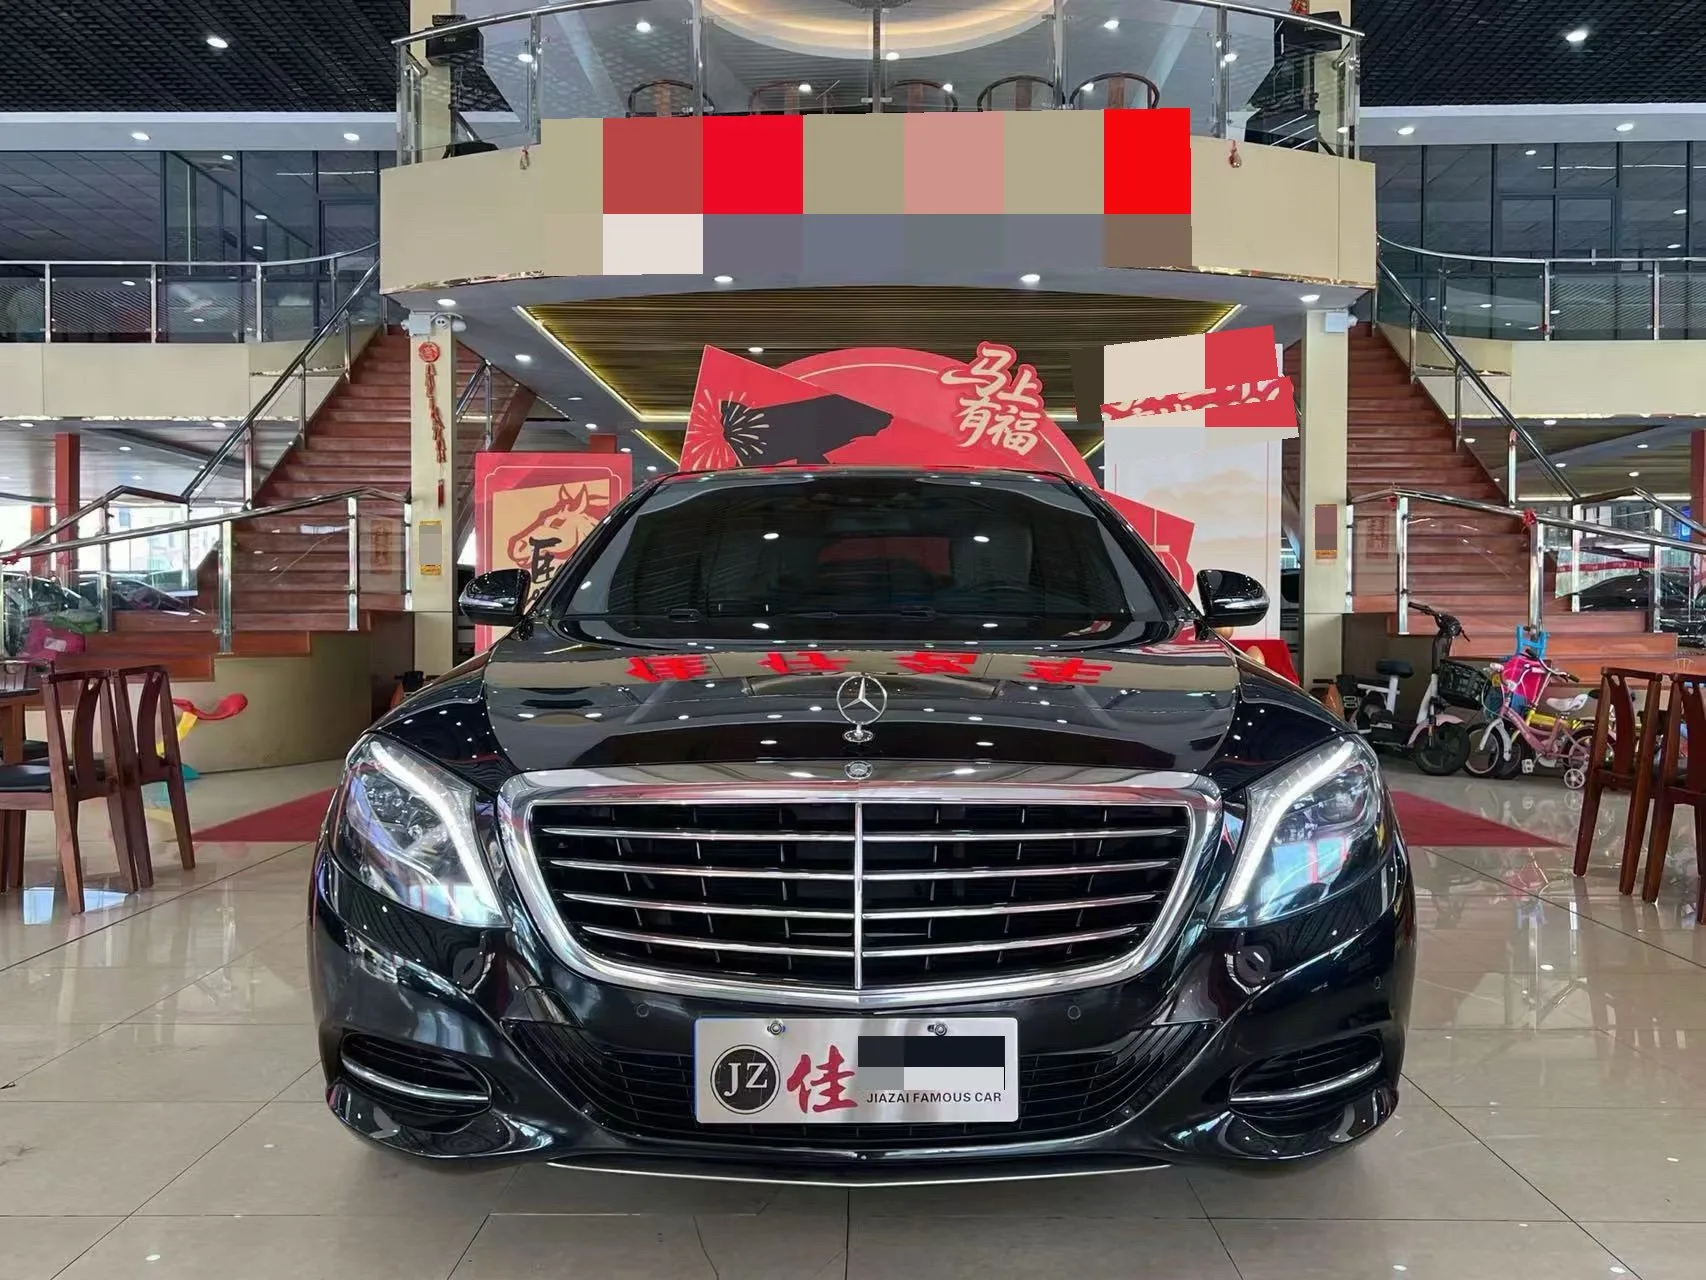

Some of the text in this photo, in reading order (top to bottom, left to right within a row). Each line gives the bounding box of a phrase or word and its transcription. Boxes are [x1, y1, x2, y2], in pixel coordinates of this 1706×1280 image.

[941, 347, 1039, 408] 马上
[955, 396, 1041, 456] 有福
[723, 1062, 768, 1097] JZ
[787, 1045, 858, 1114] 佳
[866, 1092, 1002, 1104] JIAZAI FAMOUS CAR
